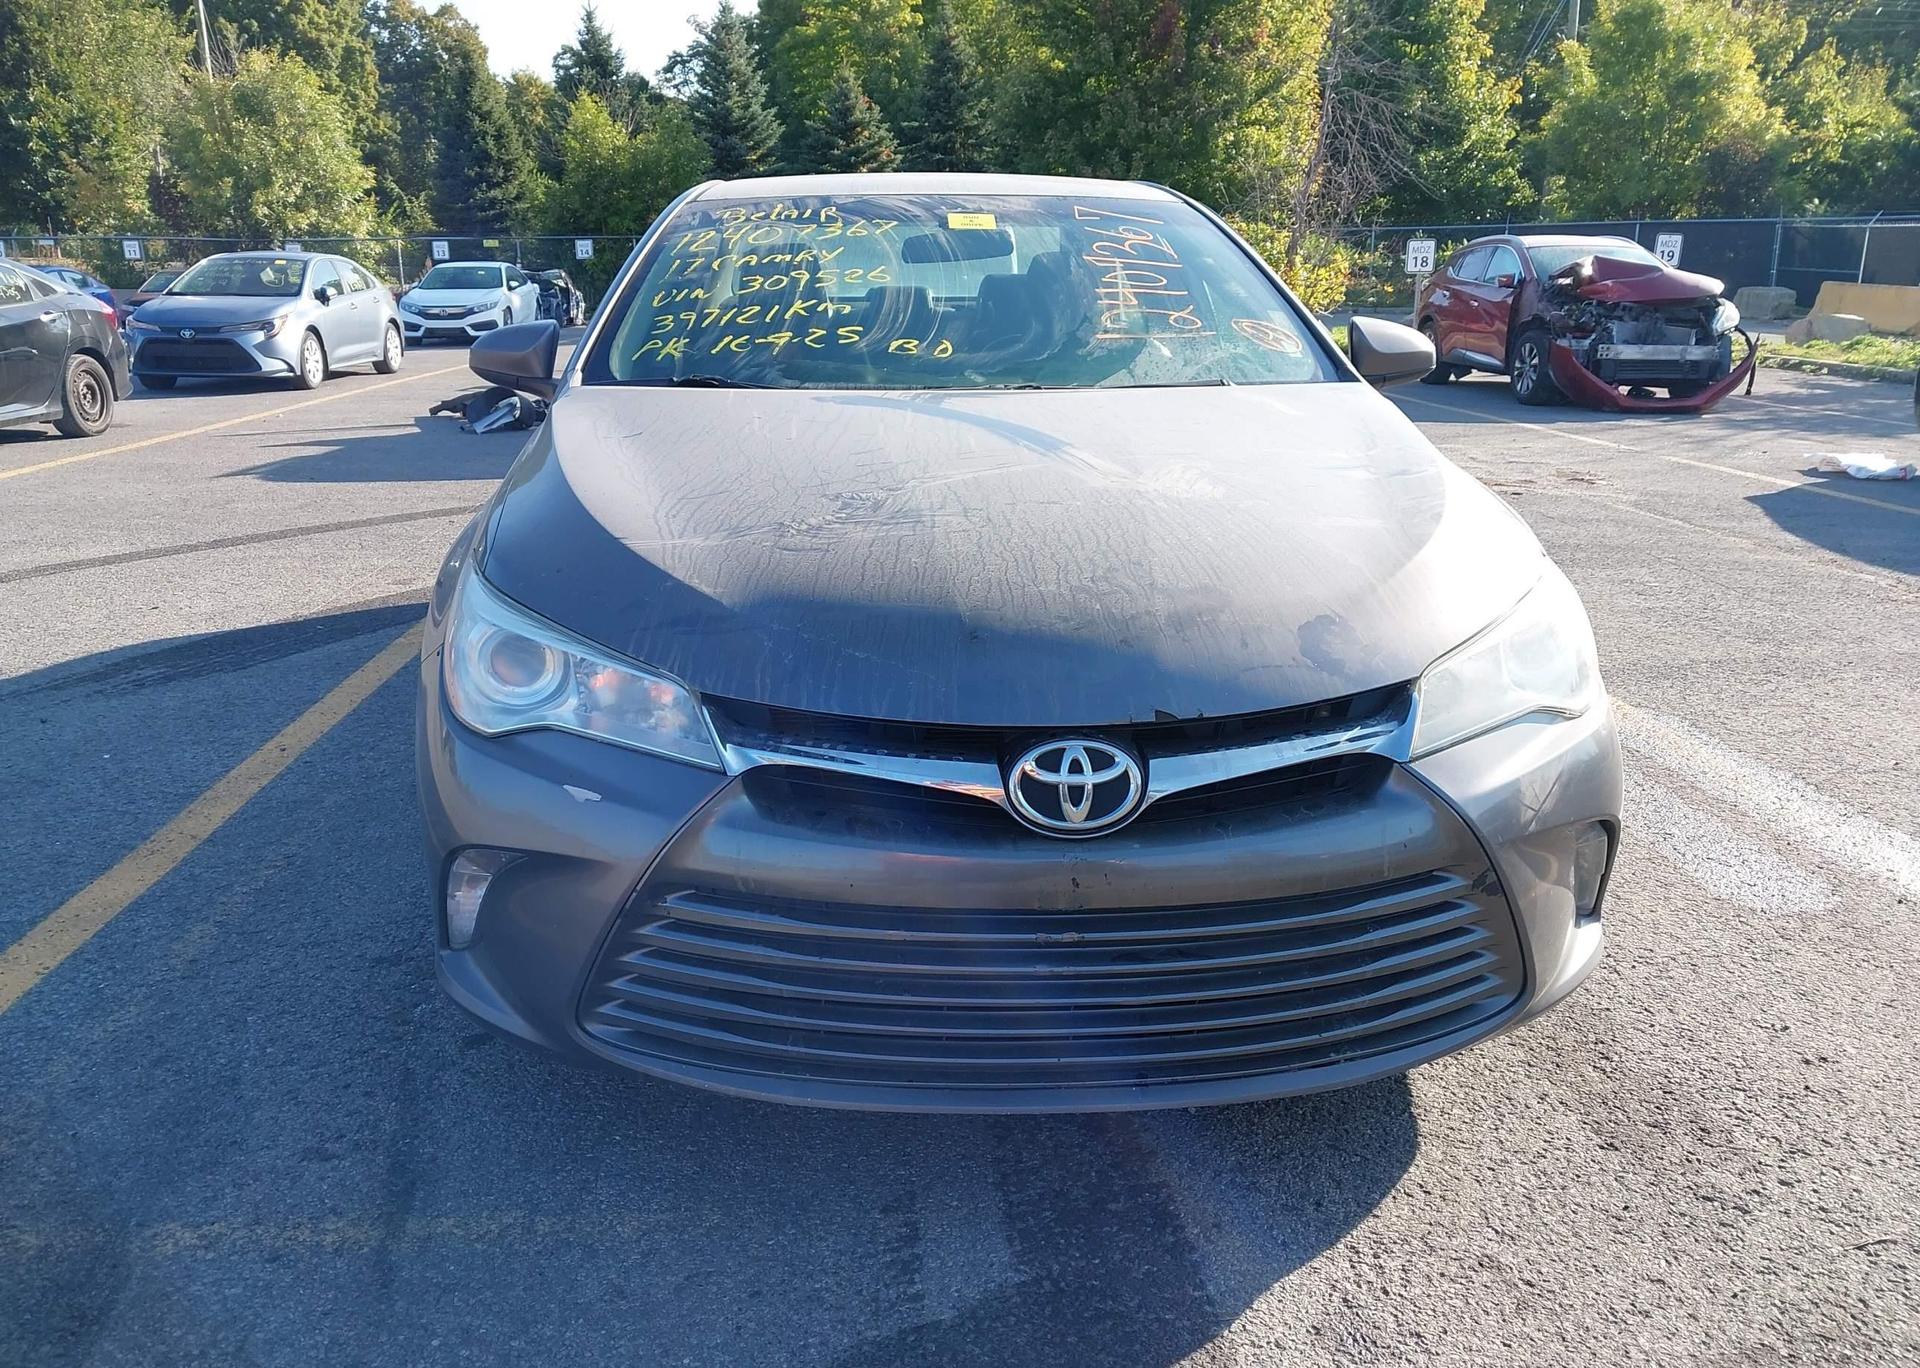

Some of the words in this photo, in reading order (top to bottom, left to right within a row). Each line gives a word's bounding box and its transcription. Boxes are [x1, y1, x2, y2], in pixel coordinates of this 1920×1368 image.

[1412, 246, 1431, 254] MDZ
[1659, 240, 1678, 248] MDZ
[1412, 256, 1429, 268] 18
[1660, 250, 1675, 262] 19
[736, 266, 891, 295] 309526
